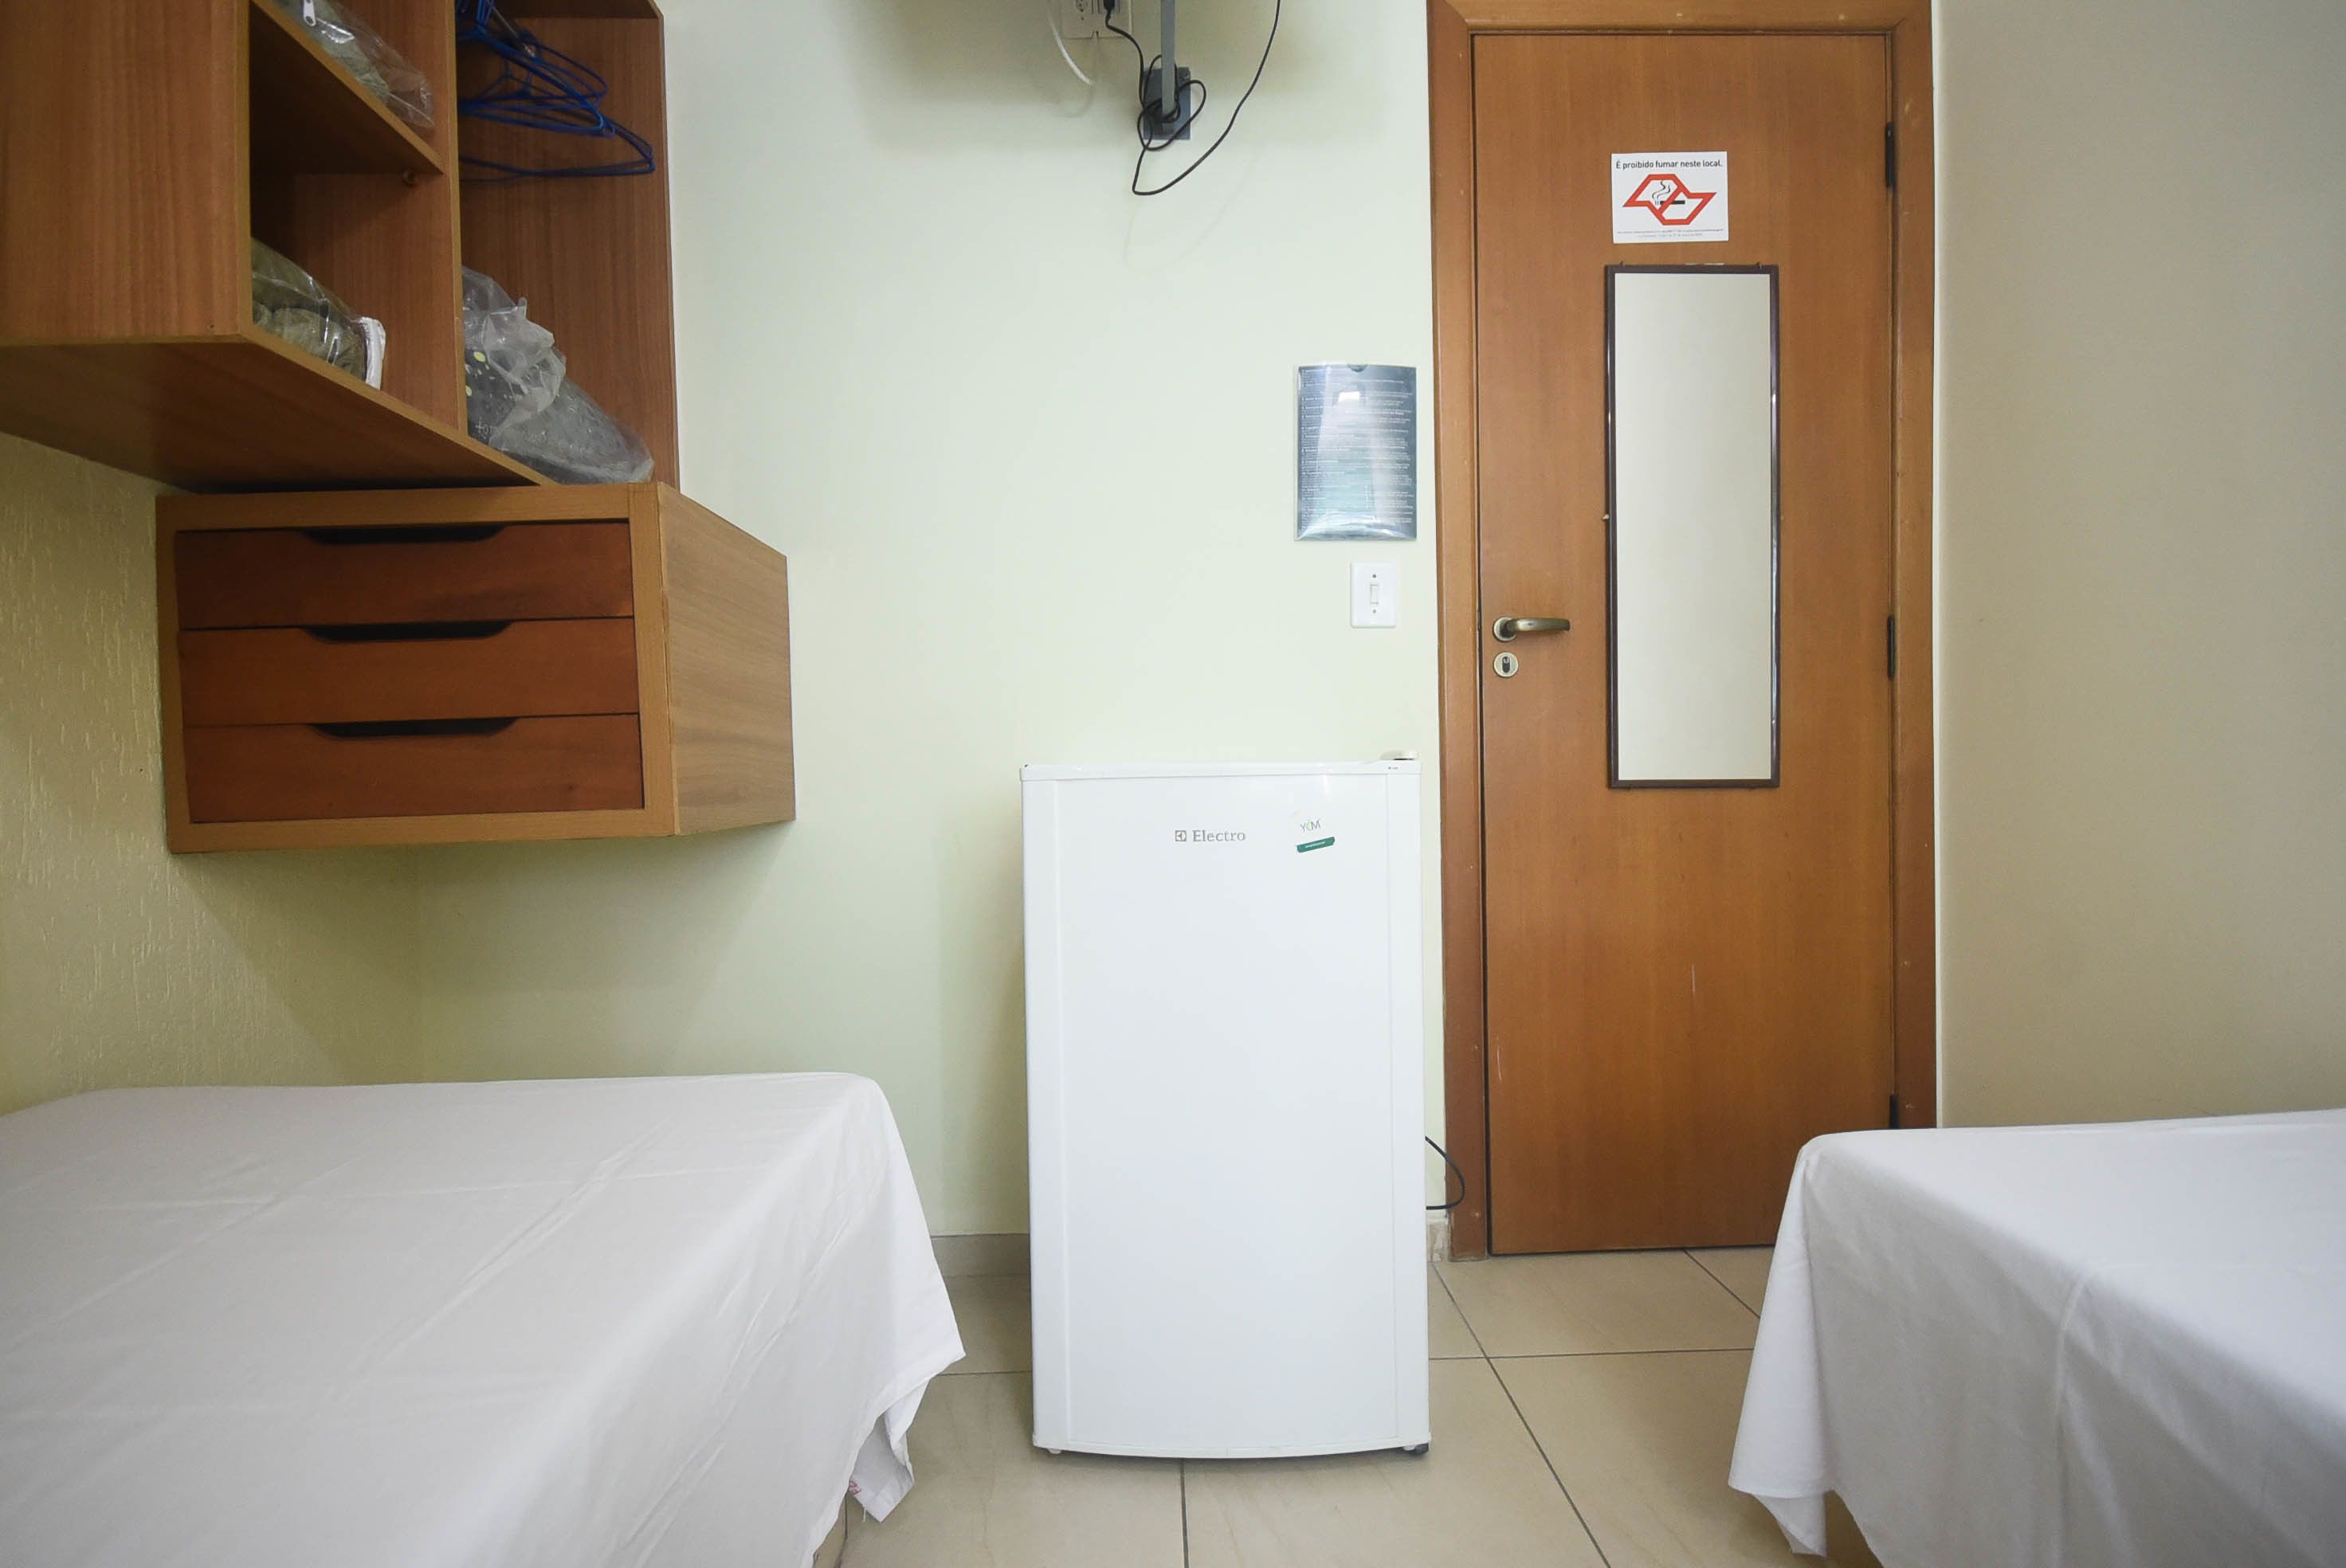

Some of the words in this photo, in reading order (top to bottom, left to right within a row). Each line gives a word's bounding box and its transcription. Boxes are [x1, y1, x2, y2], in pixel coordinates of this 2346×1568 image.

[1616, 160, 1621, 169] É
[1622, 161, 1654, 170] proibido
[1192, 829, 1246, 842] Electro
